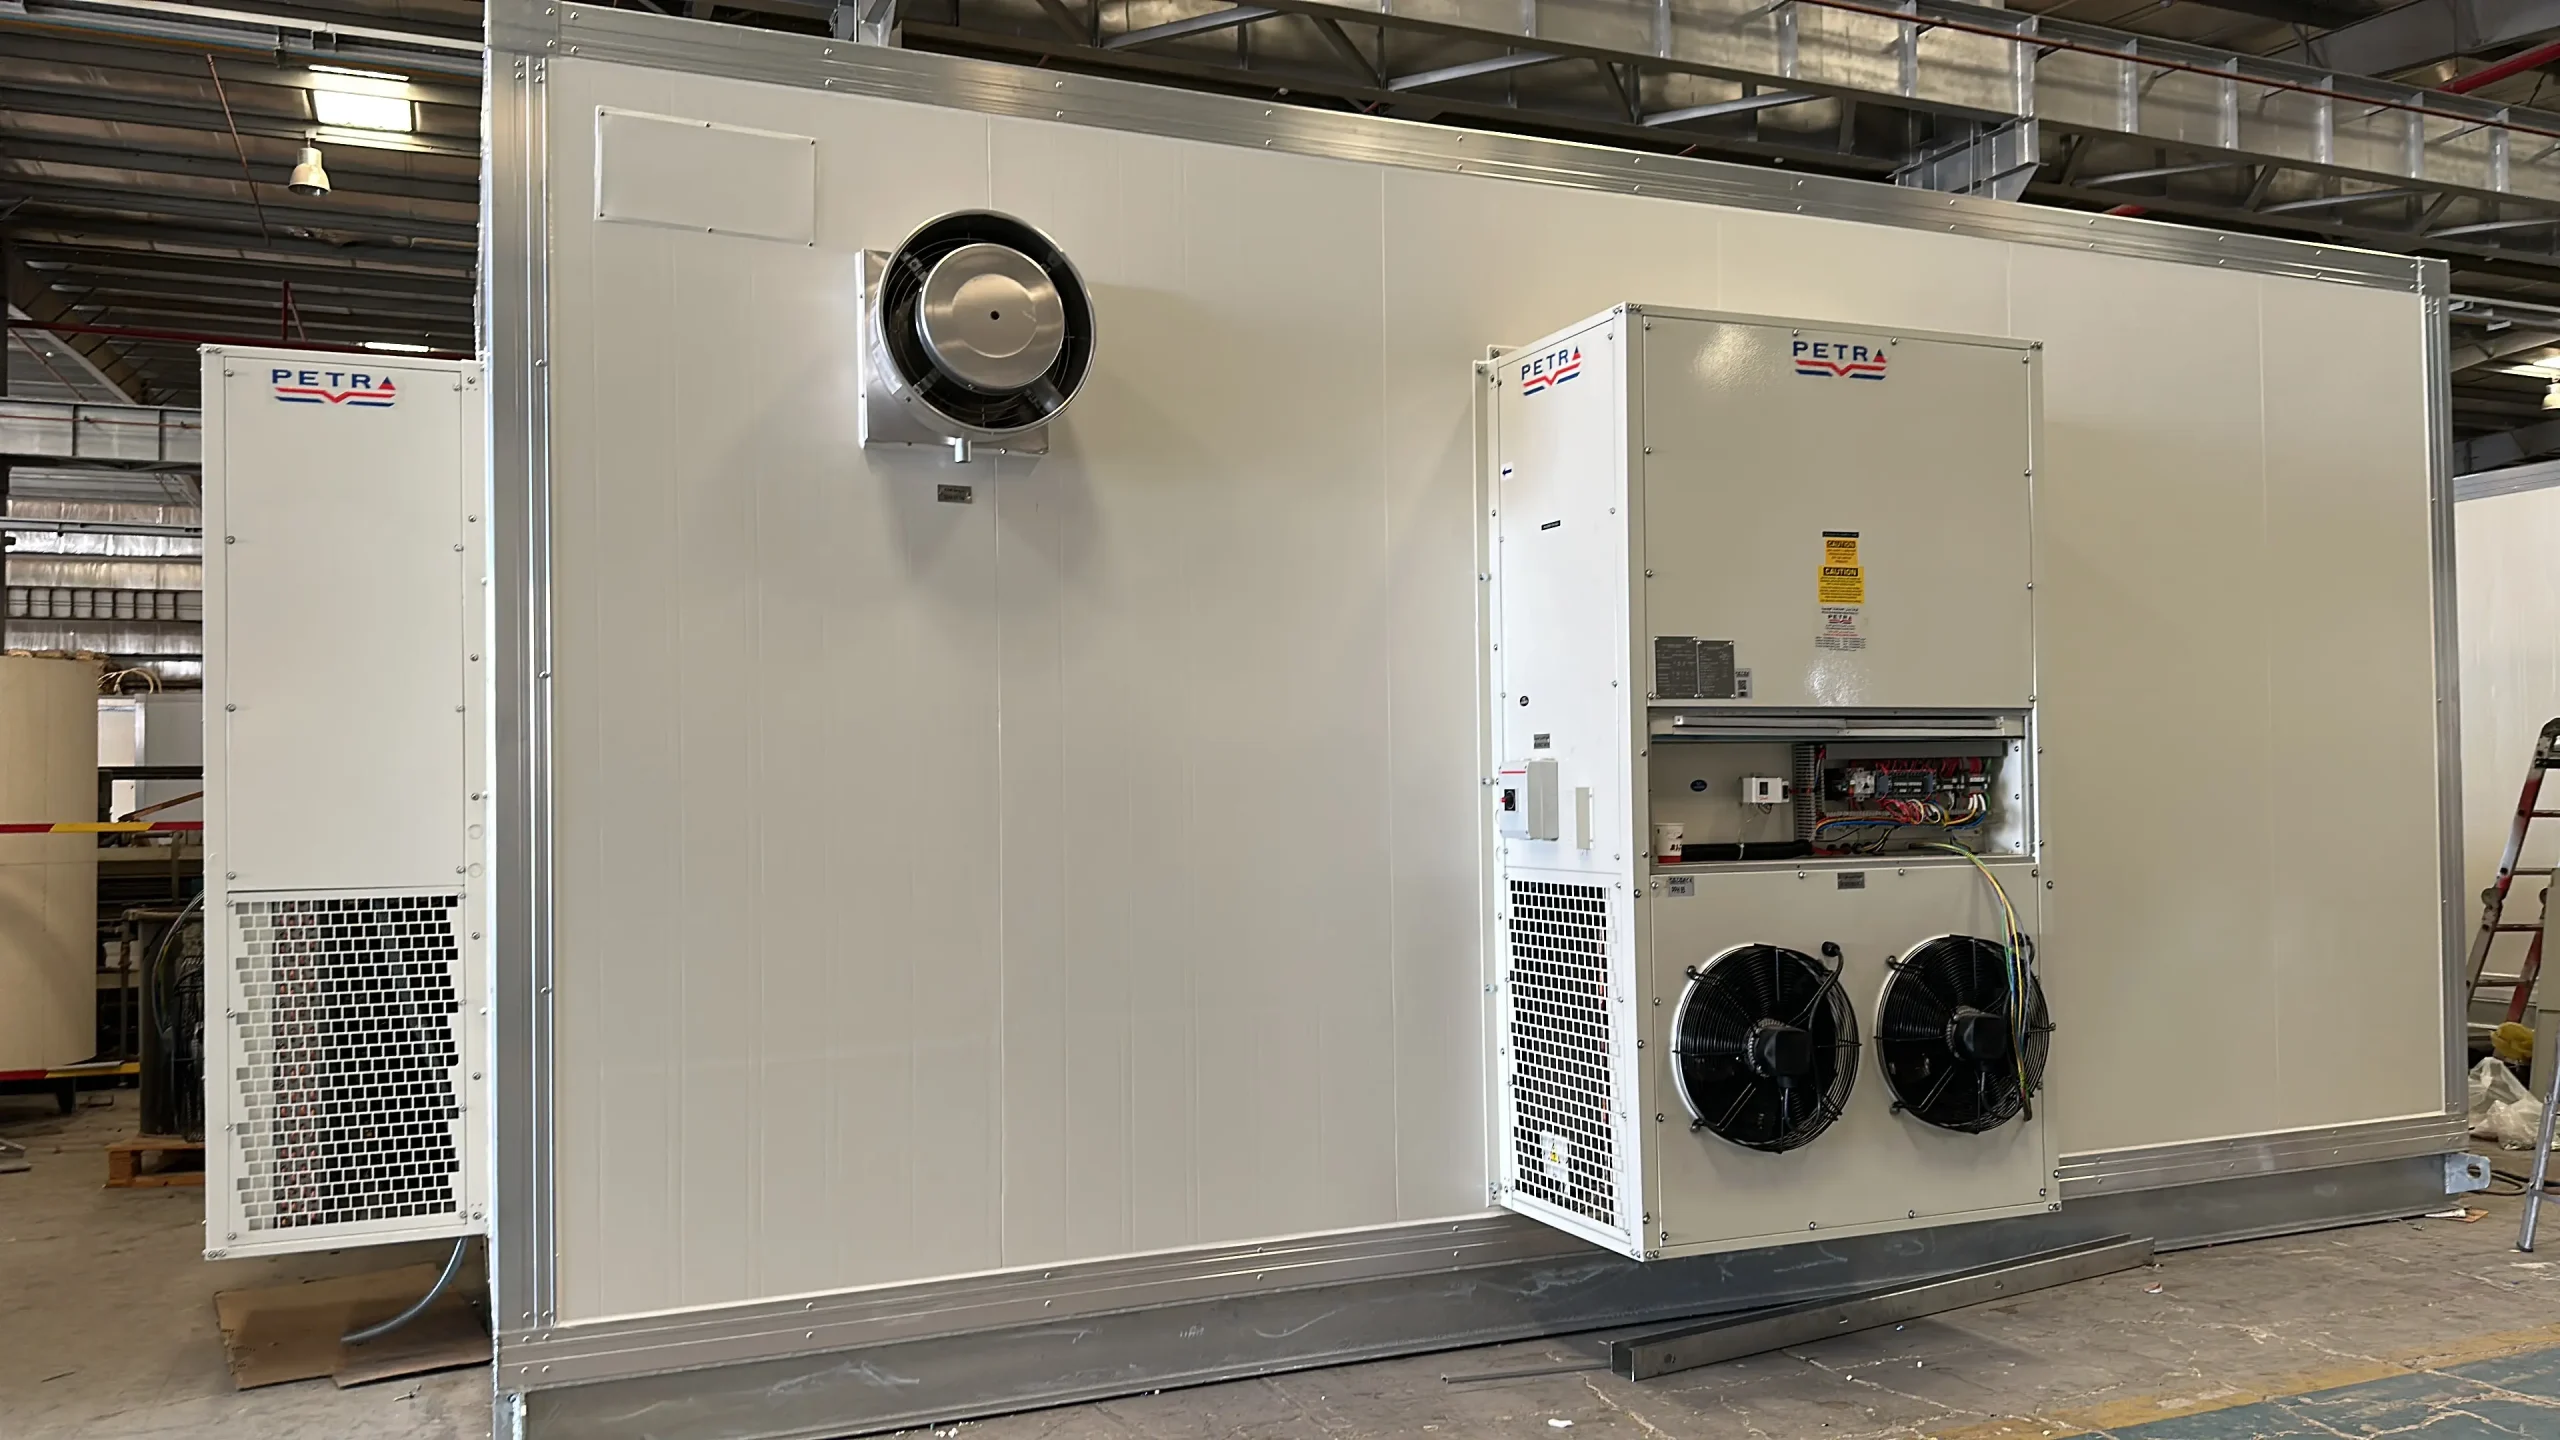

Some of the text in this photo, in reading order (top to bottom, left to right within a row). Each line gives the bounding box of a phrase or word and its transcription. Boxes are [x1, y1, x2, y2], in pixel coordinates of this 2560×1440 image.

[1521, 345, 1581, 380] PETRA
[1793, 341, 1887, 363] PETRA
[272, 369, 396, 390] PETRA
[1827, 541, 1856, 549] CAUTION
[1825, 568, 1857, 576] CAUTION
